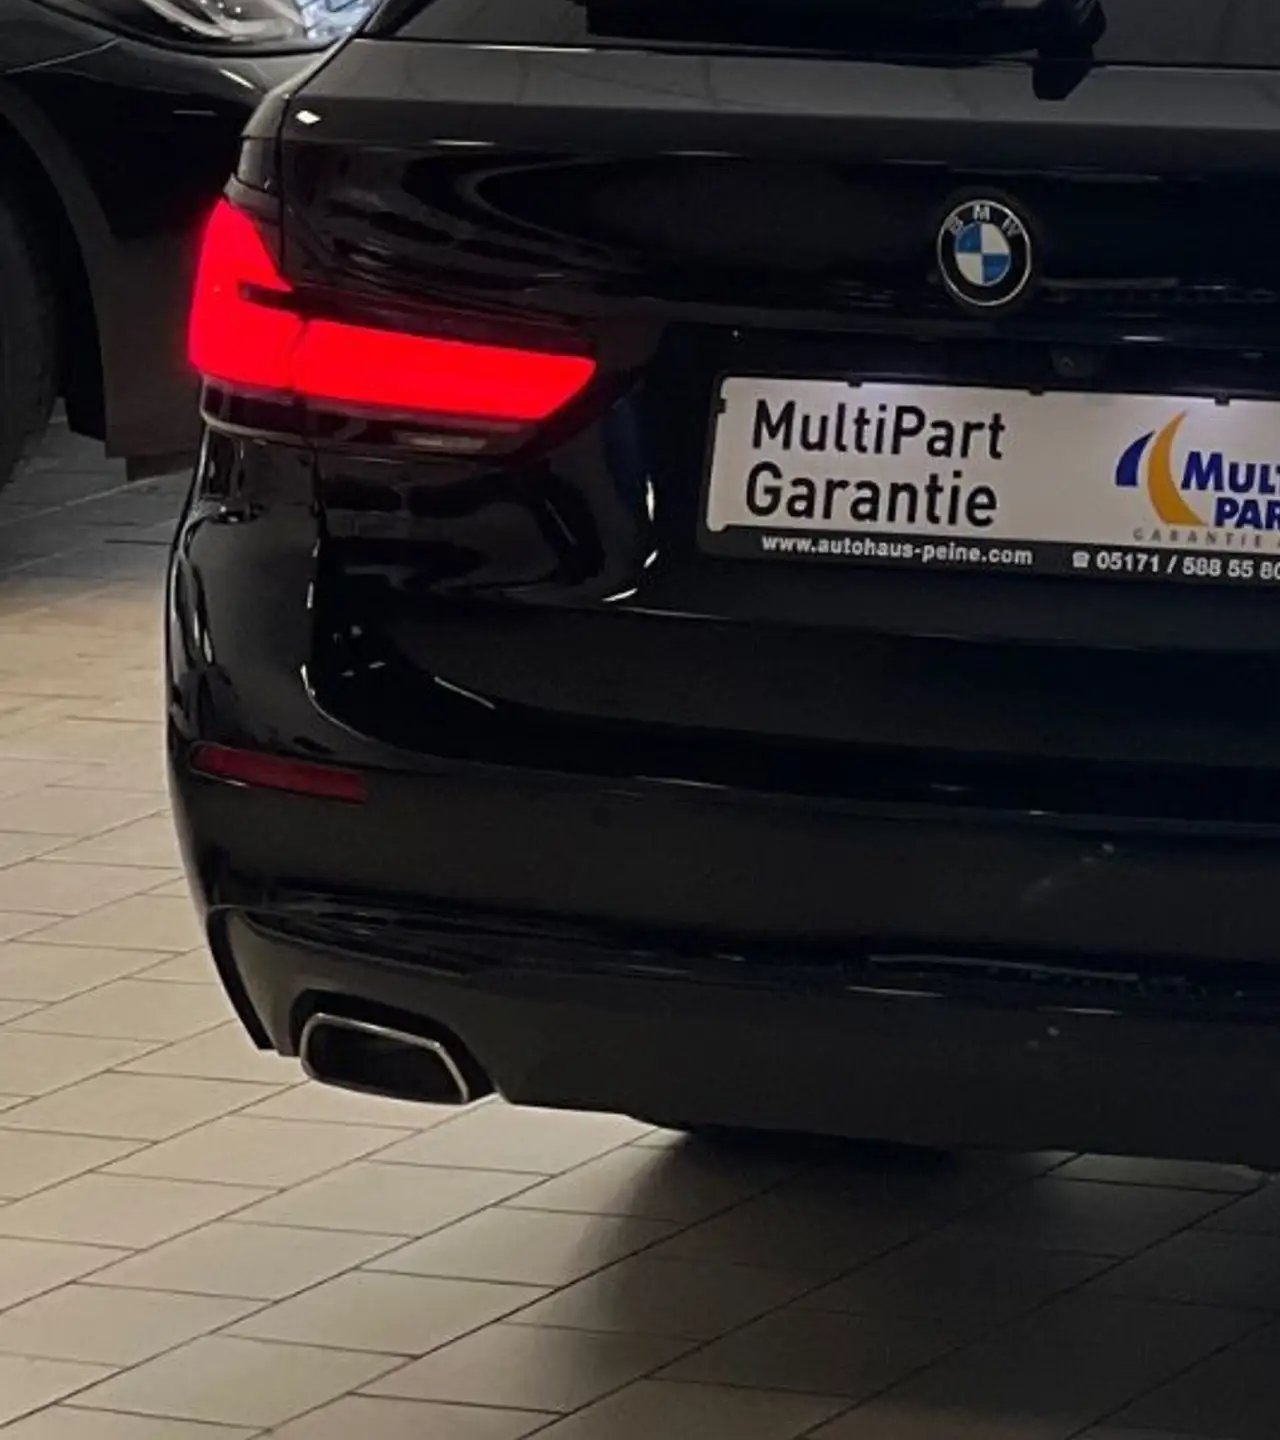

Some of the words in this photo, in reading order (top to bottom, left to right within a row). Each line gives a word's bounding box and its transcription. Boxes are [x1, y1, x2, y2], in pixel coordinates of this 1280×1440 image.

[944, 204, 1022, 237] BMW
[752, 398, 1006, 459] MultiPart
[746, 461, 998, 527] Garantie
[761, 534, 1033, 564] www.autohaus-peine.com
[1133, 528, 1262, 547] GARANTIE
[1096, 551, 1159, 574] 05171
